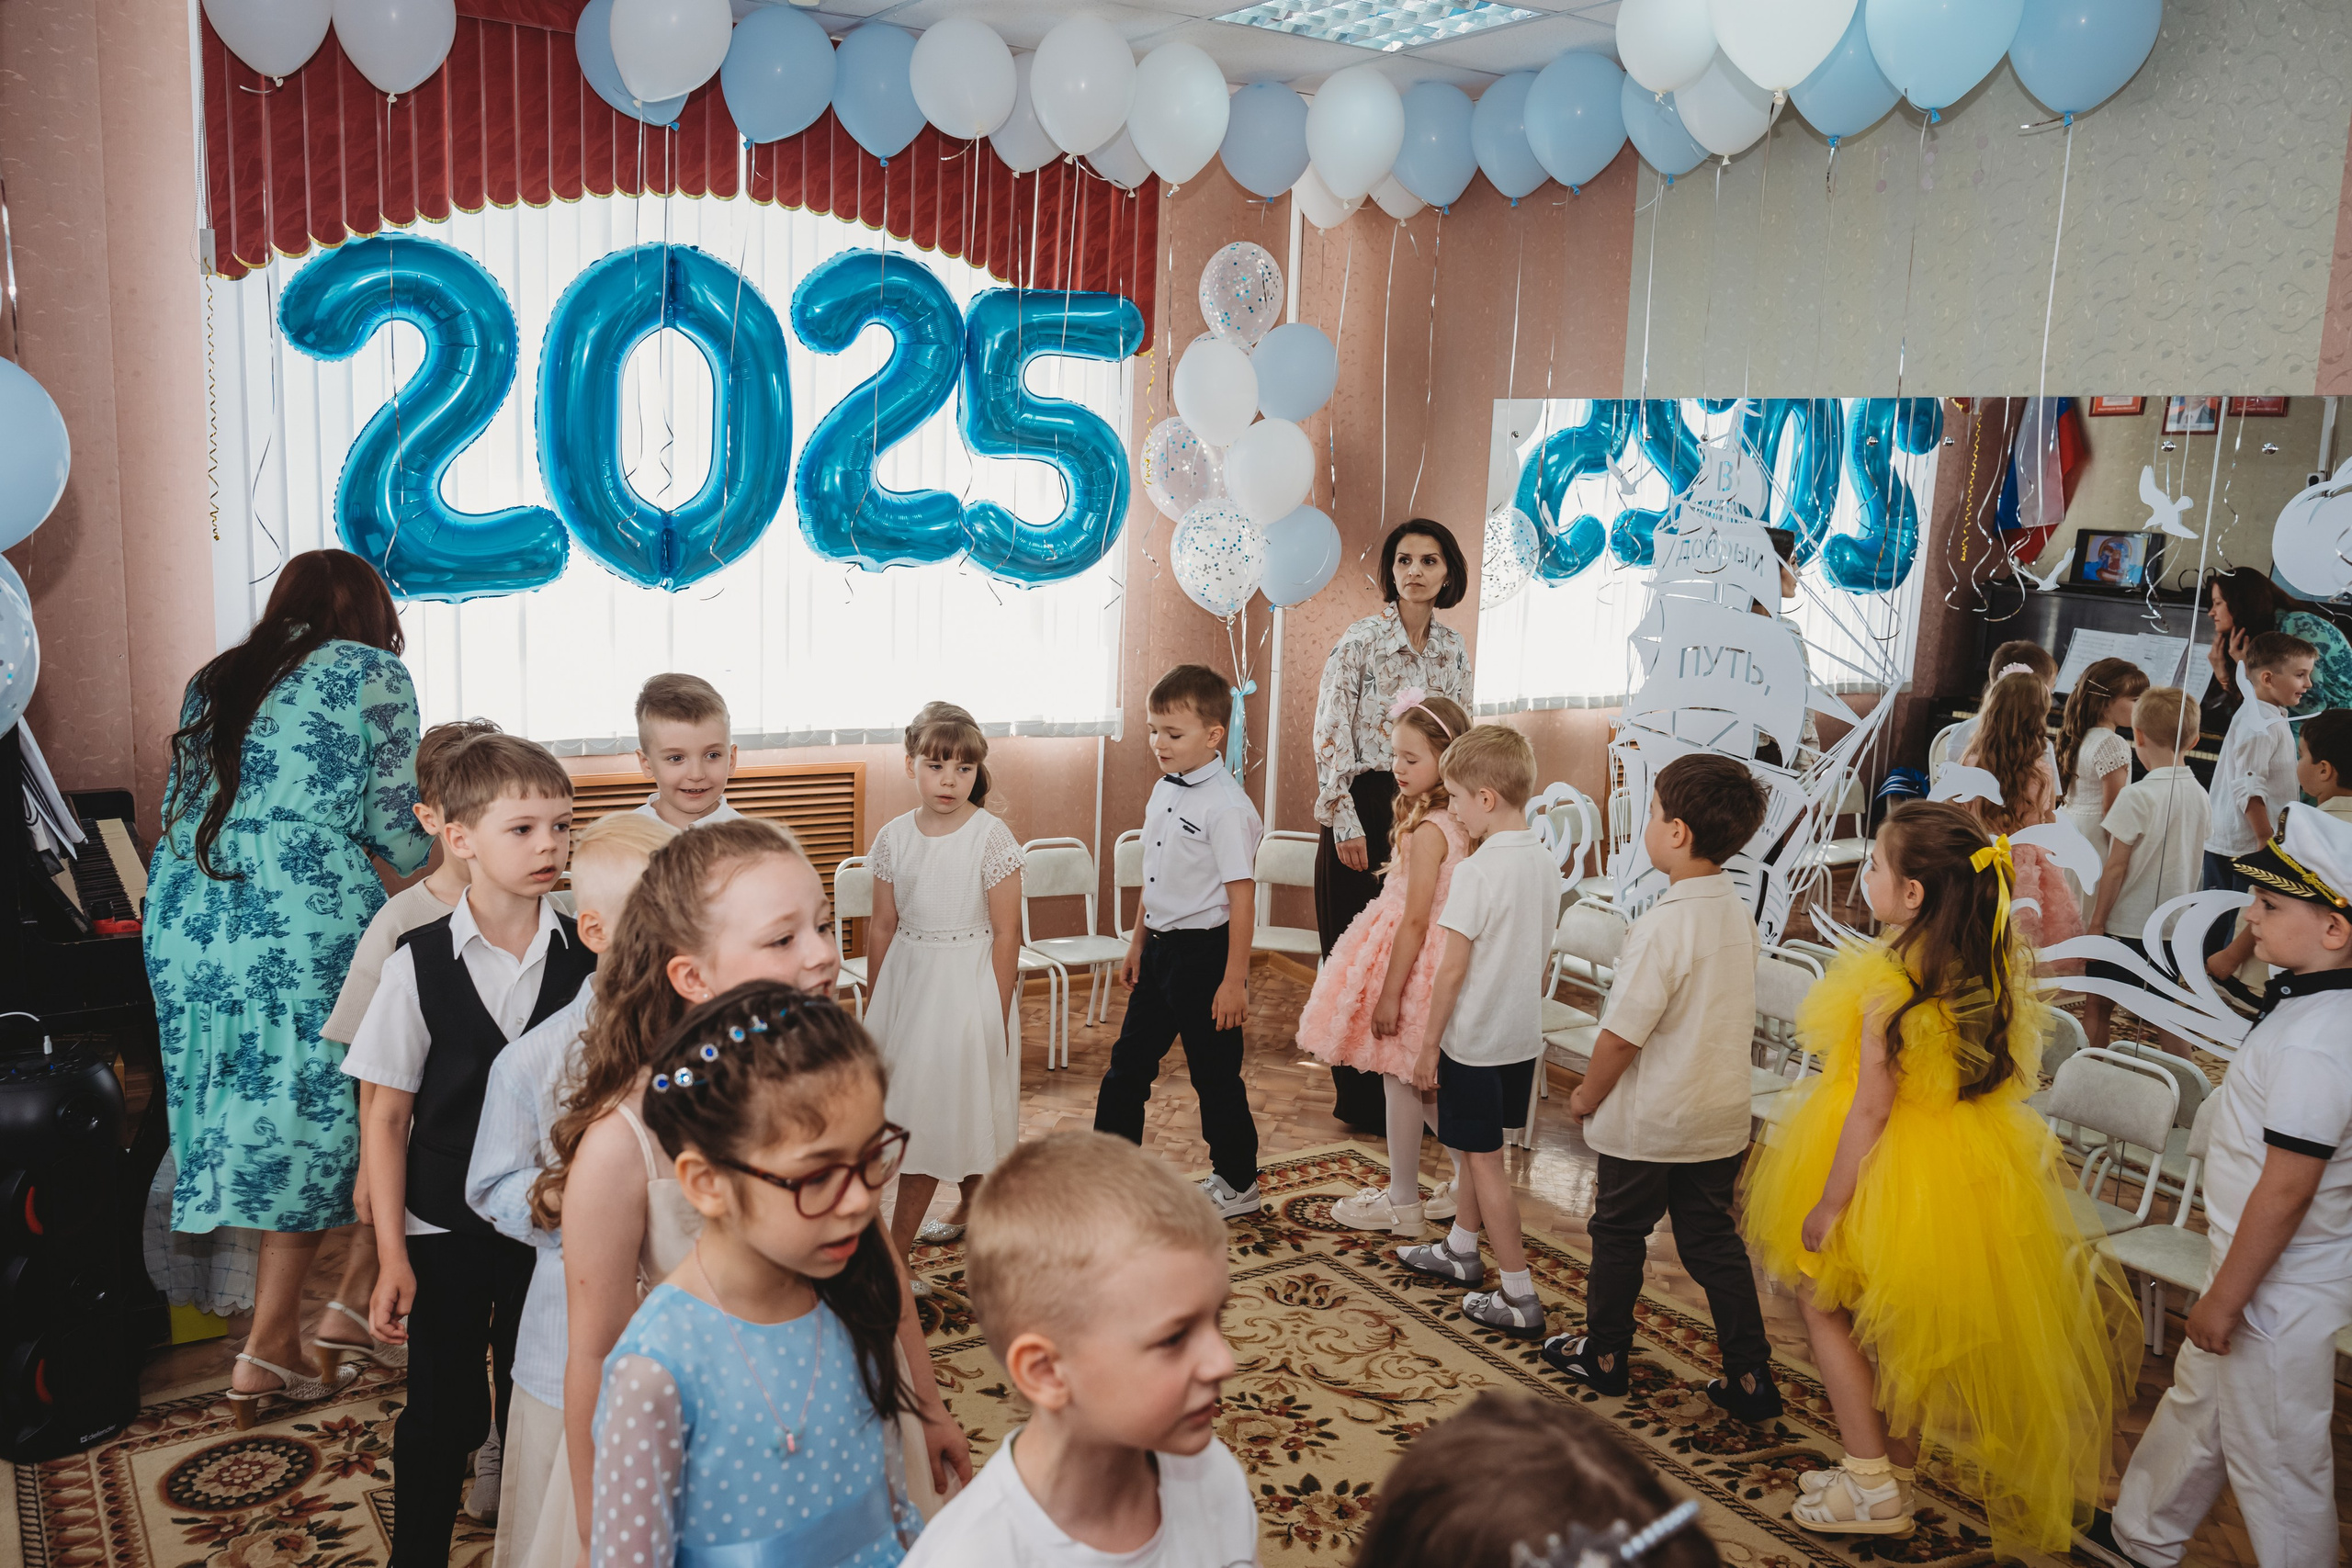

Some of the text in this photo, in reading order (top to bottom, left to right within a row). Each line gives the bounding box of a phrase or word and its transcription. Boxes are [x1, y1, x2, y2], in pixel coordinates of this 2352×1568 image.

[277, 231, 1145, 604] 2025
[1716, 460, 1735, 492] В
[1679, 645, 1771, 696] ПУТЬ,
[87, 1424, 117, 1440] defender
